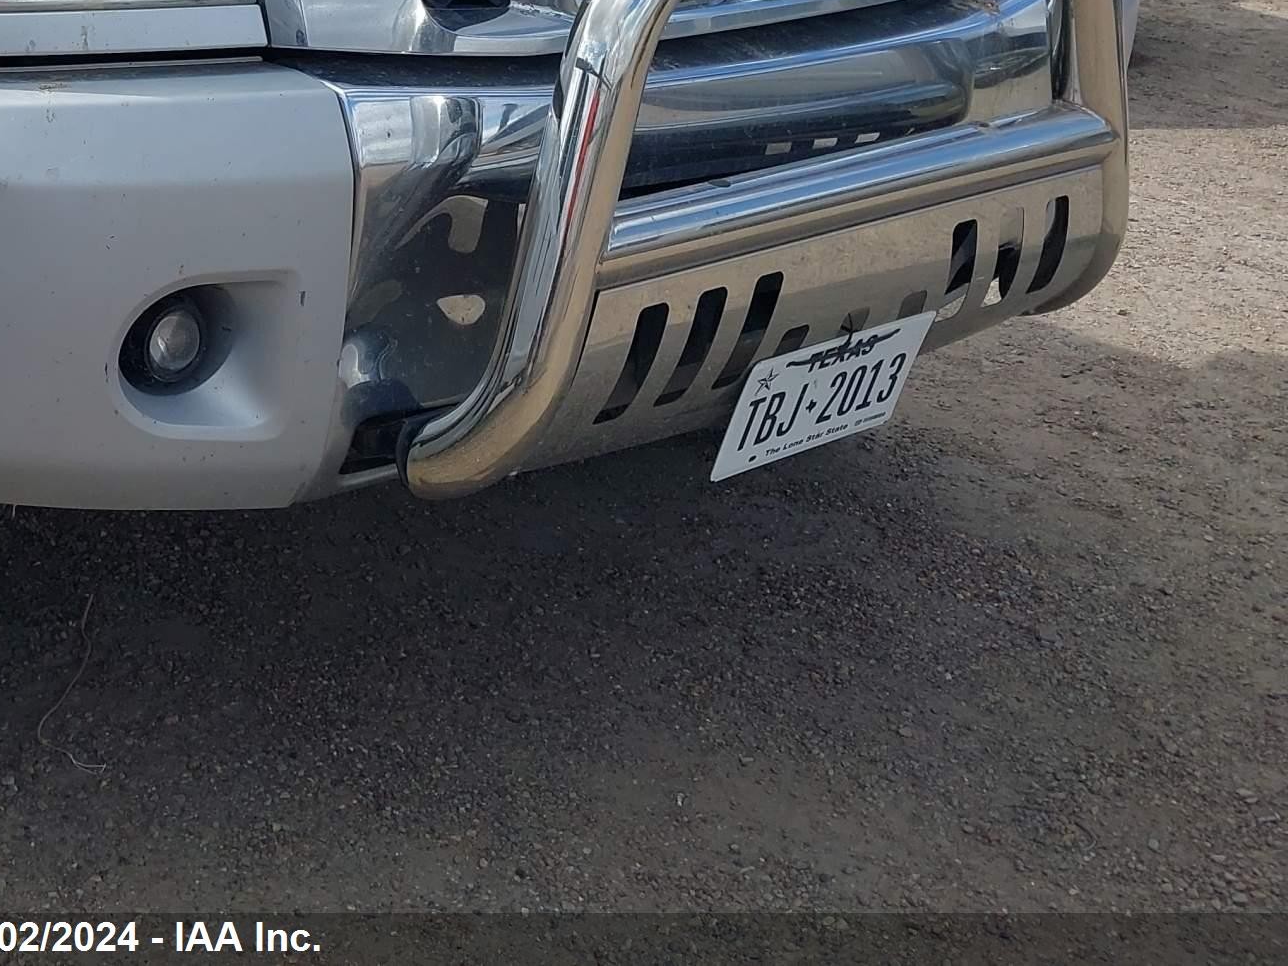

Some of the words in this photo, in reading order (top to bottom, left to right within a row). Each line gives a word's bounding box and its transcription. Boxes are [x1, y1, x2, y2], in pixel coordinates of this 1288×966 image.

[808, 334, 878, 373] TEXAS
[764, 446, 781, 457] The
[783, 439, 804, 451] Lone
[806, 431, 824, 444] Star
[826, 423, 848, 435] State
